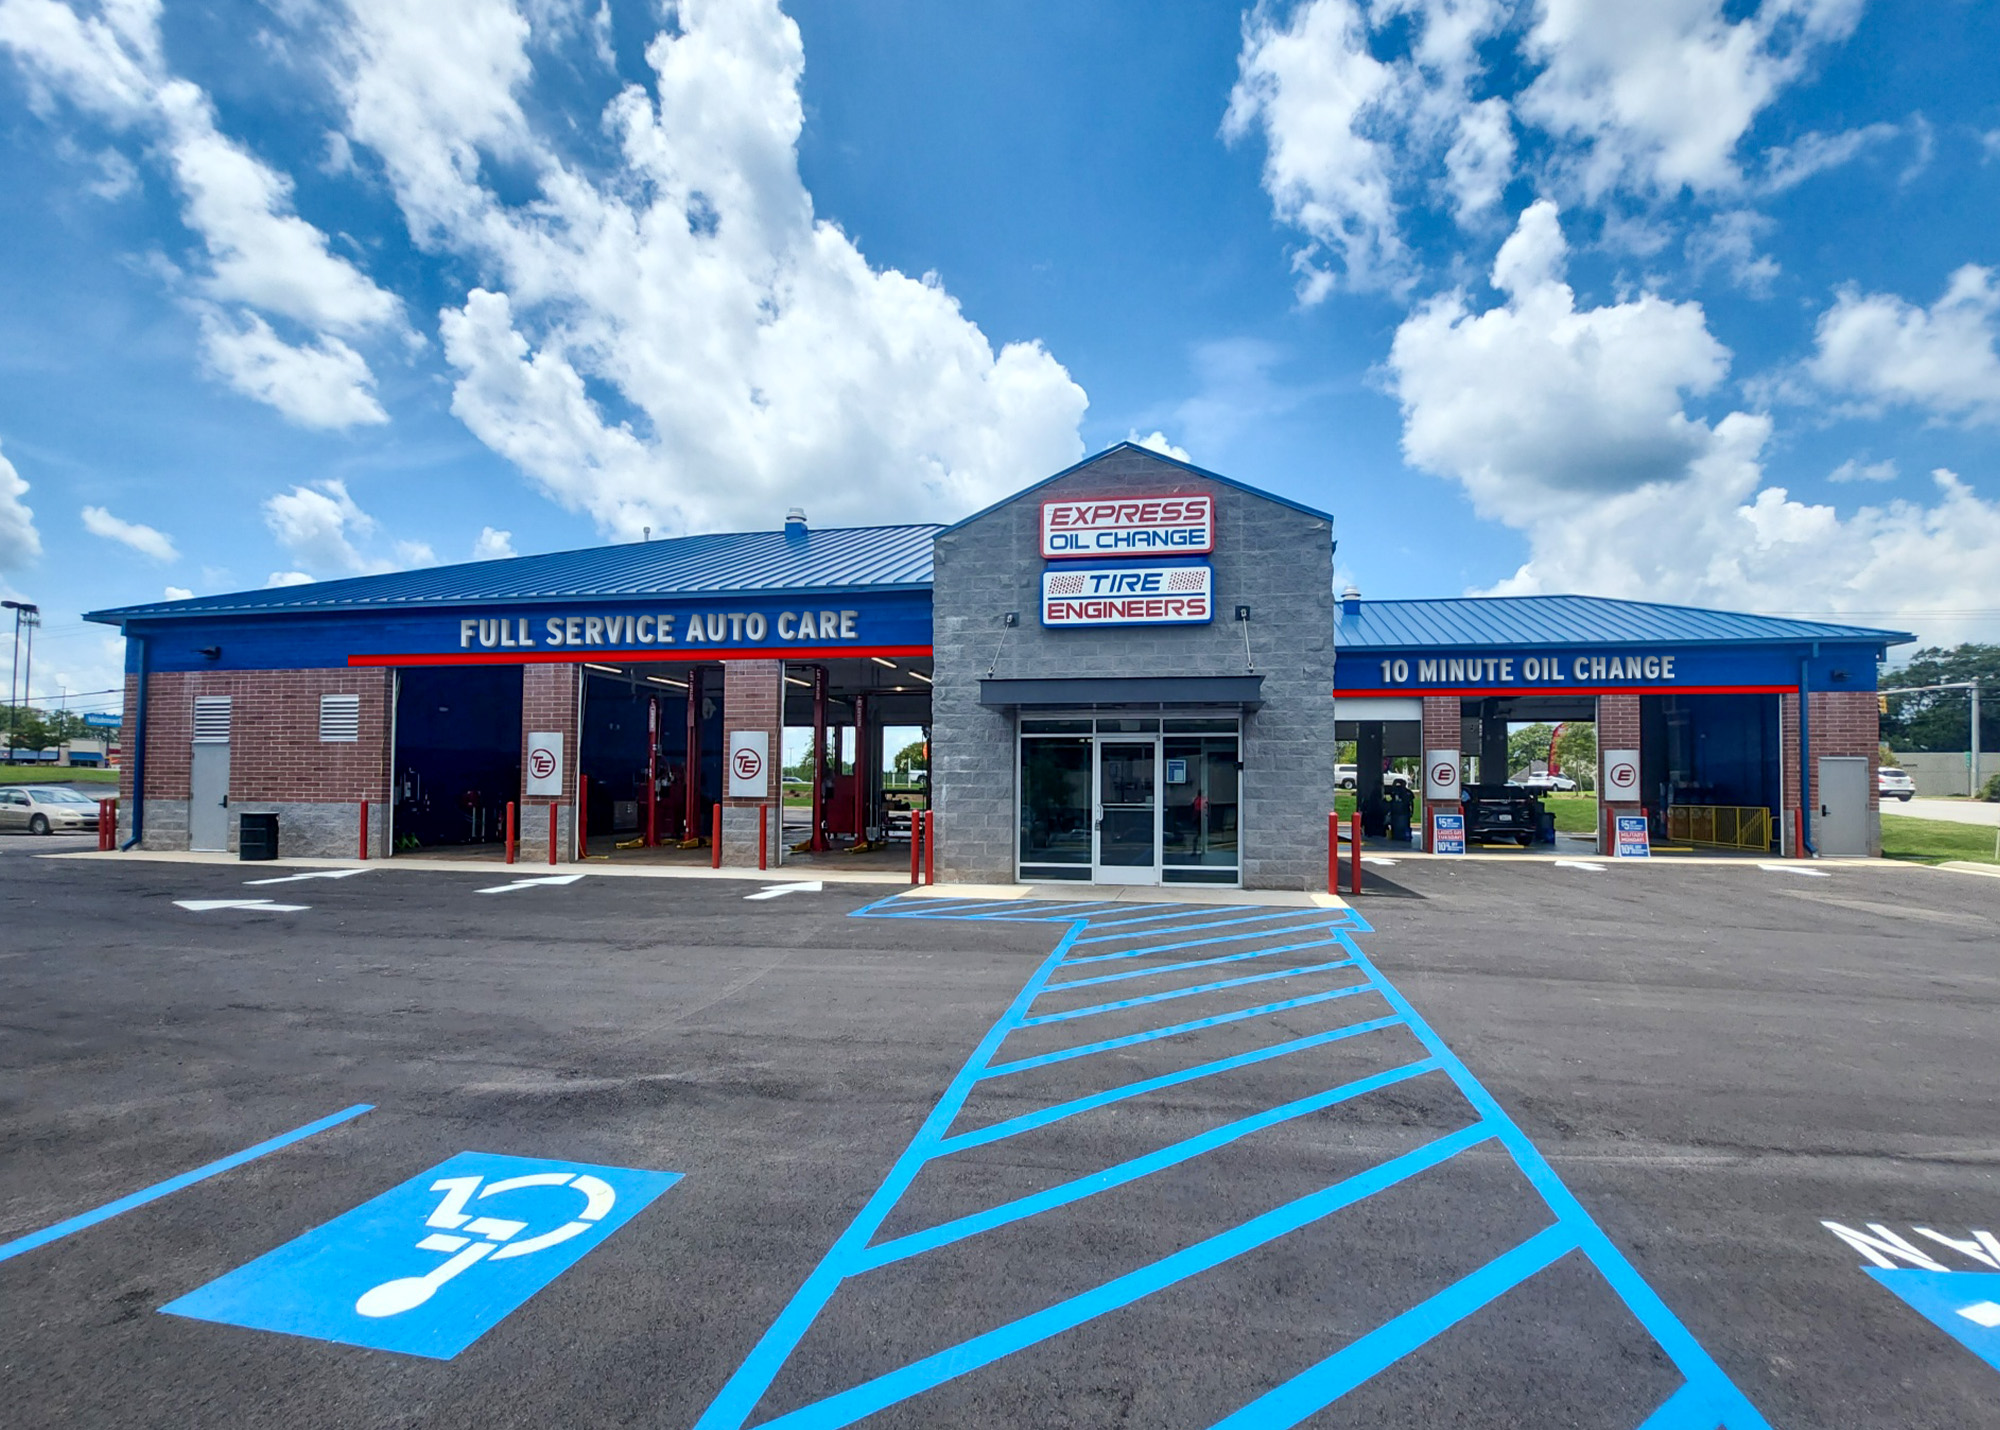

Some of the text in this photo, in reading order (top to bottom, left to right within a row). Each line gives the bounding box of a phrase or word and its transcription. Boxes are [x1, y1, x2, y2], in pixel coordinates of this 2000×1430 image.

[1050, 500, 1207, 526] EXPRESS
[1050, 528, 1206, 550] OIL CHANGE
[1089, 573, 1163, 593] TIRE
[1047, 599, 1206, 620] ENGINEERS
[460, 609, 859, 648] FULL SERVICE AUTO CARE
[1381, 655, 1676, 683] 10 MINUTE OIL CHANGE
[736, 755, 758, 773] TE
